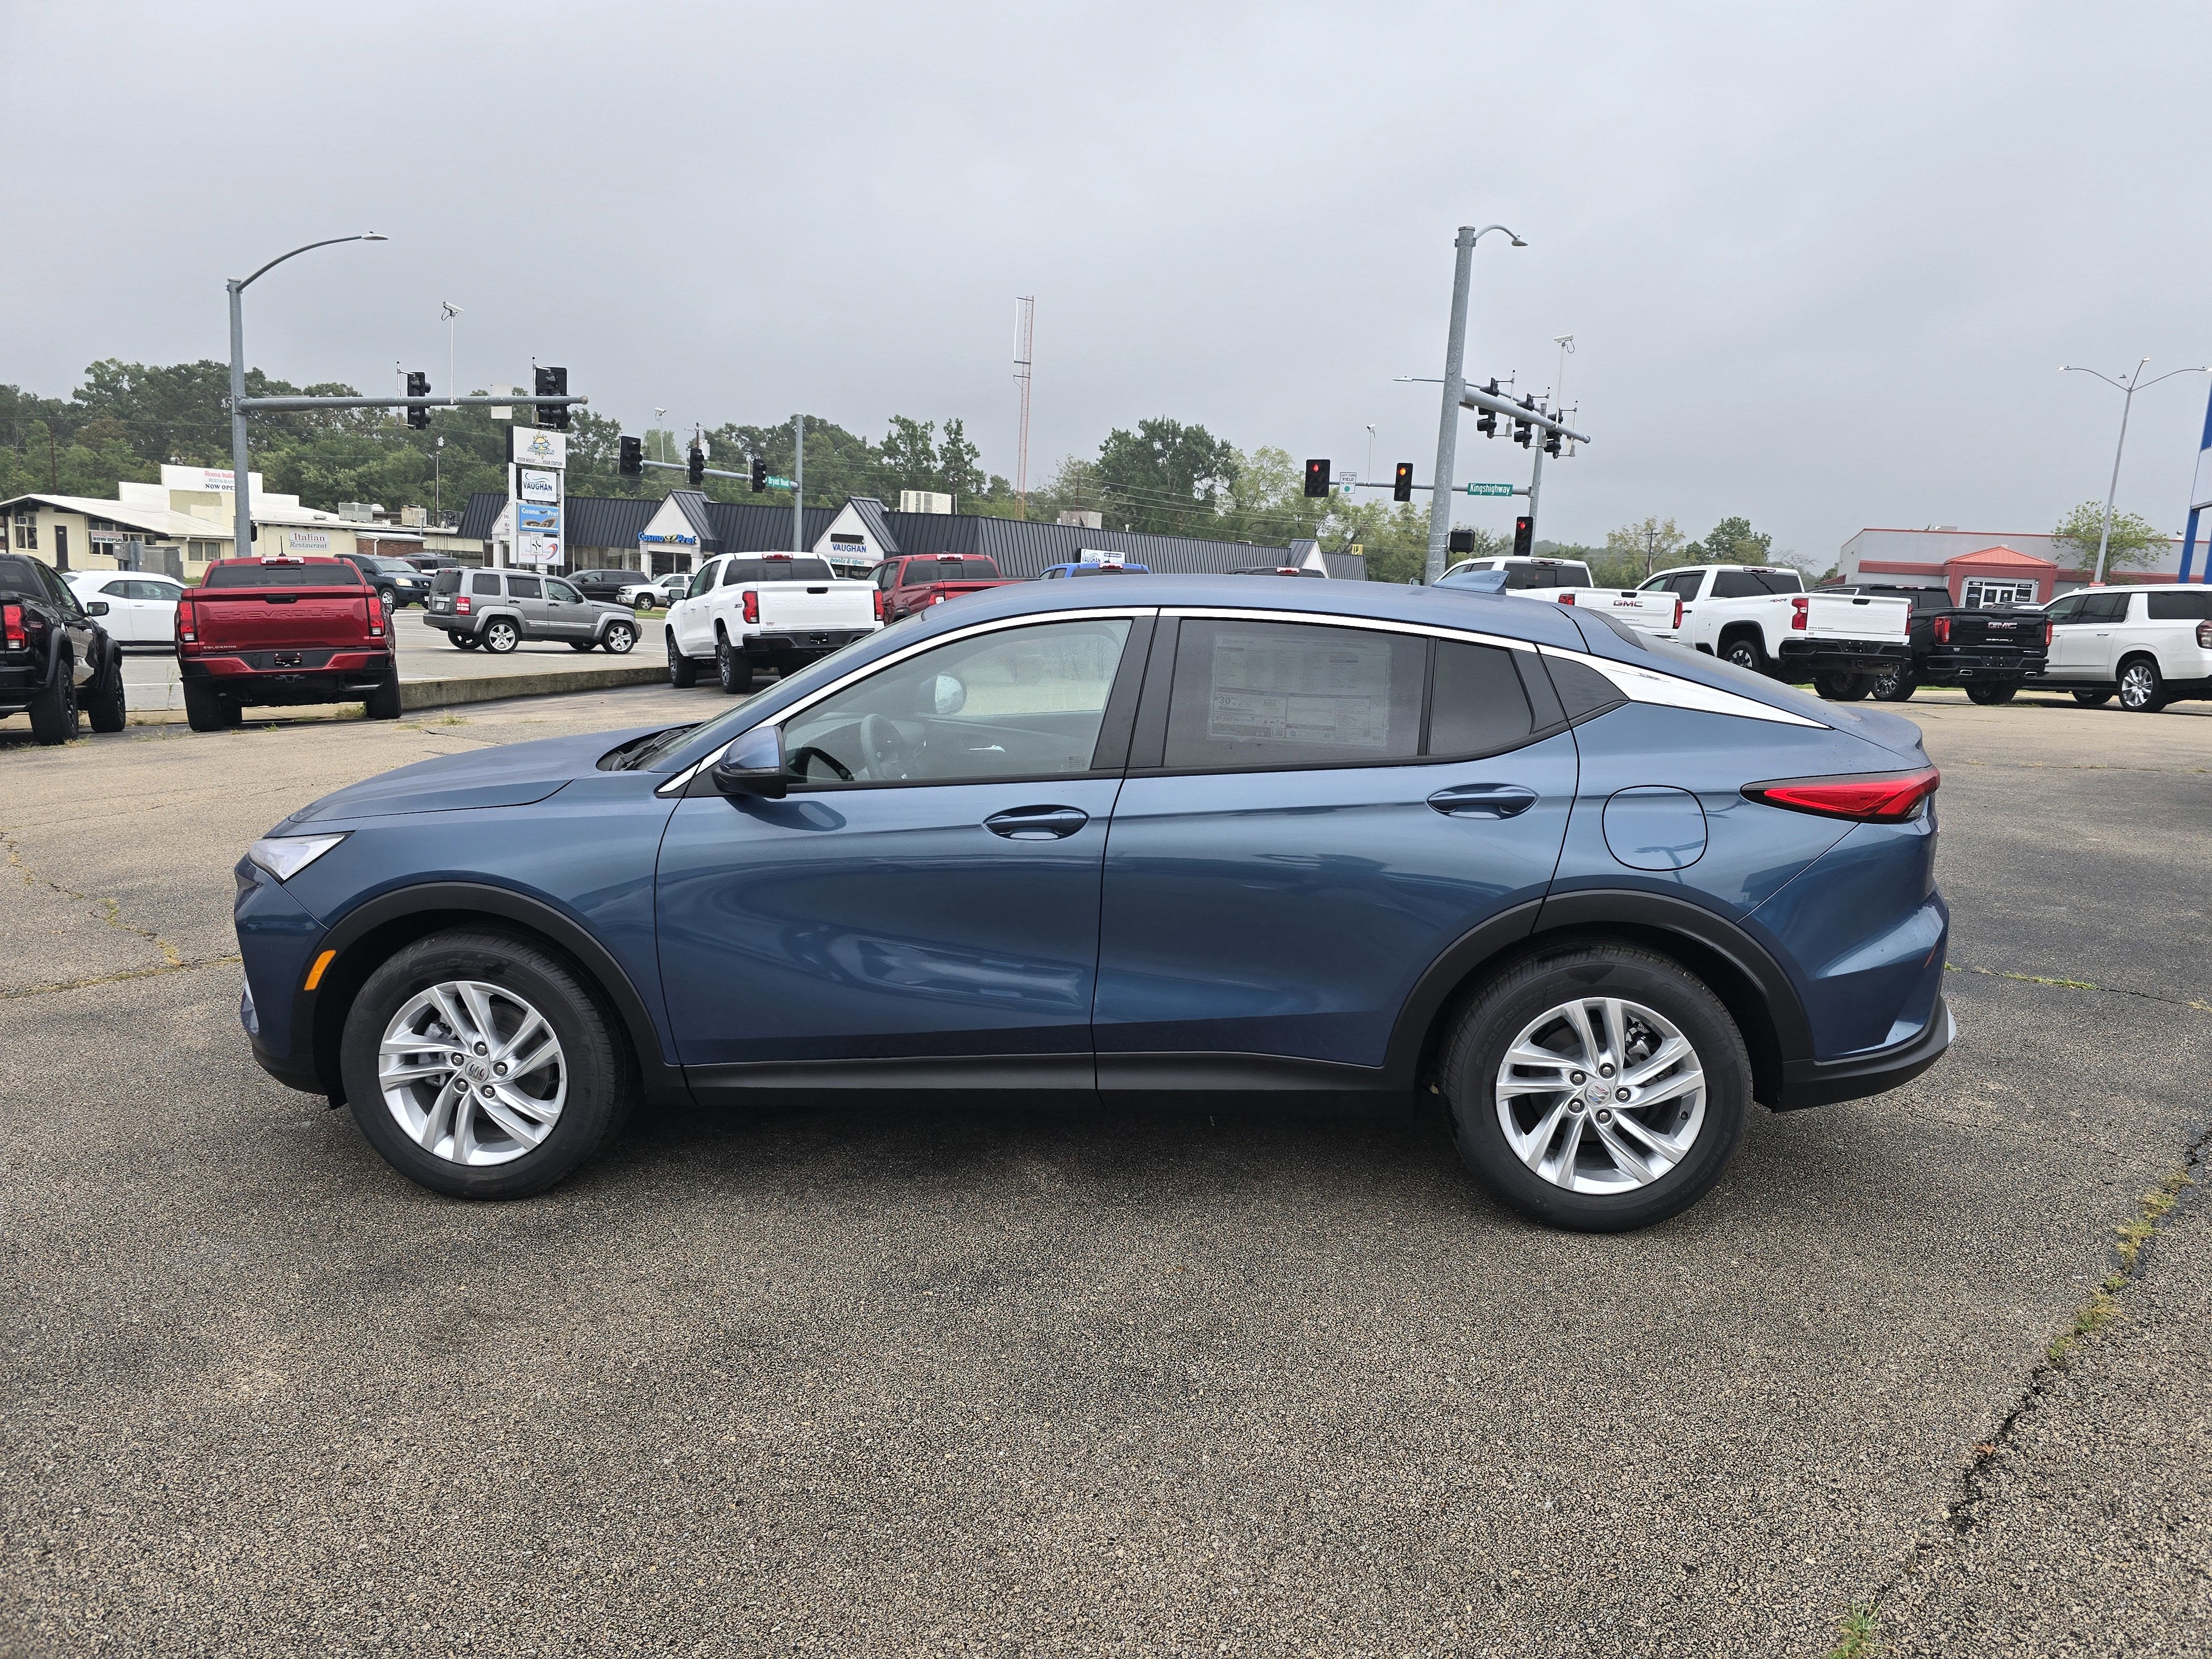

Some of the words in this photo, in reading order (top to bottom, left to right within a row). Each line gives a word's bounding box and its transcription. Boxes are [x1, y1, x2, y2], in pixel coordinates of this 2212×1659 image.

[523, 481, 552, 491] VAUGHAN
[780, 478, 789, 487] Road
[1469, 483, 1511, 495] Kingshighway
[294, 533, 325, 541] Italian
[638, 531, 665, 542] Cosmo
[677, 534, 697, 545] Prof
[832, 544, 867, 552] VAUGHAN
[213, 608, 349, 620] CHEVROLET
[1219, 696, 1231, 705] 30
